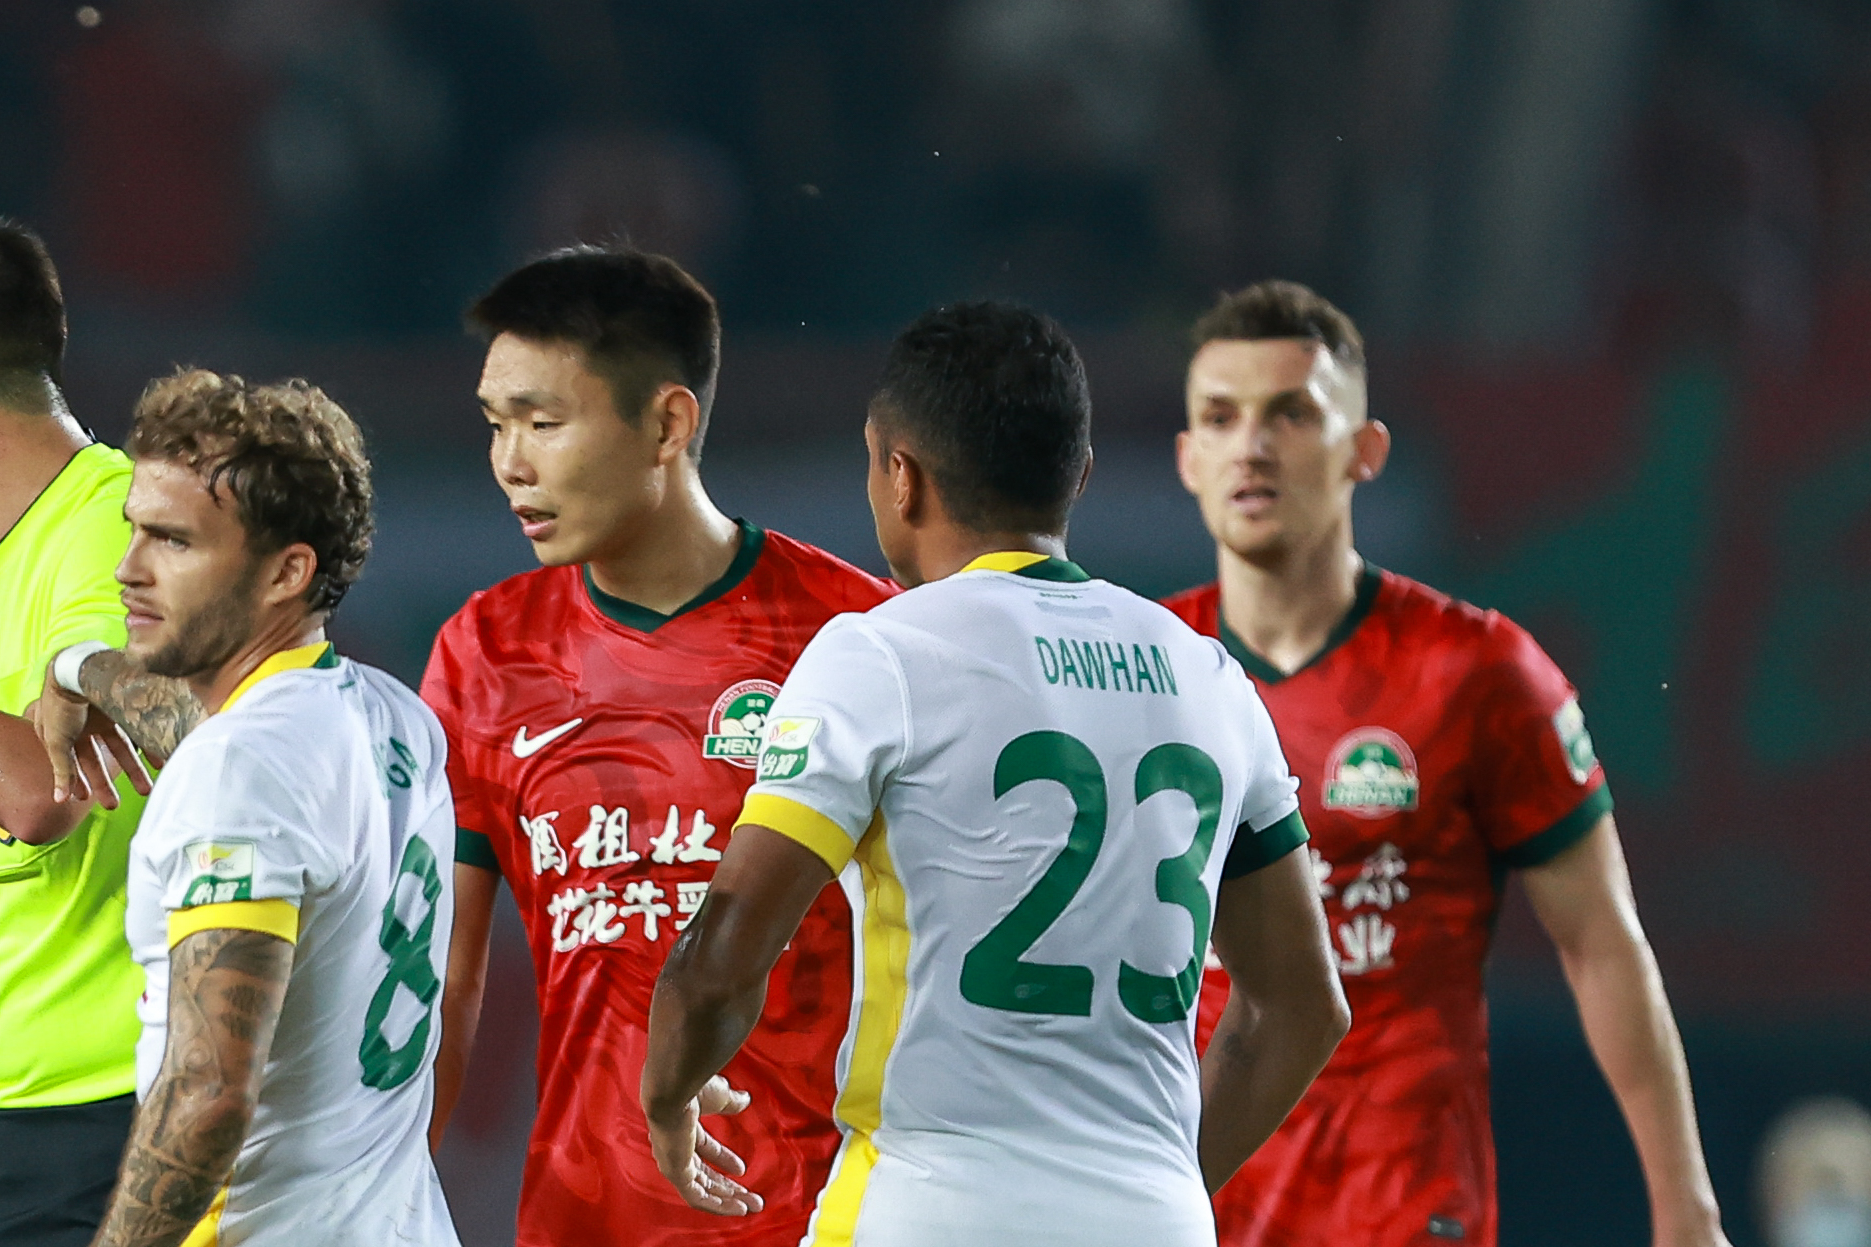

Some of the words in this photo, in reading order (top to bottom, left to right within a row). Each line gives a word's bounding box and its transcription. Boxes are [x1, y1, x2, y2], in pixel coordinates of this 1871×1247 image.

[1034, 635, 1179, 696] DAWHAN
[712, 737, 764, 755] HEN
[959, 729, 1224, 1024] 23
[359, 832, 443, 1091] 8
